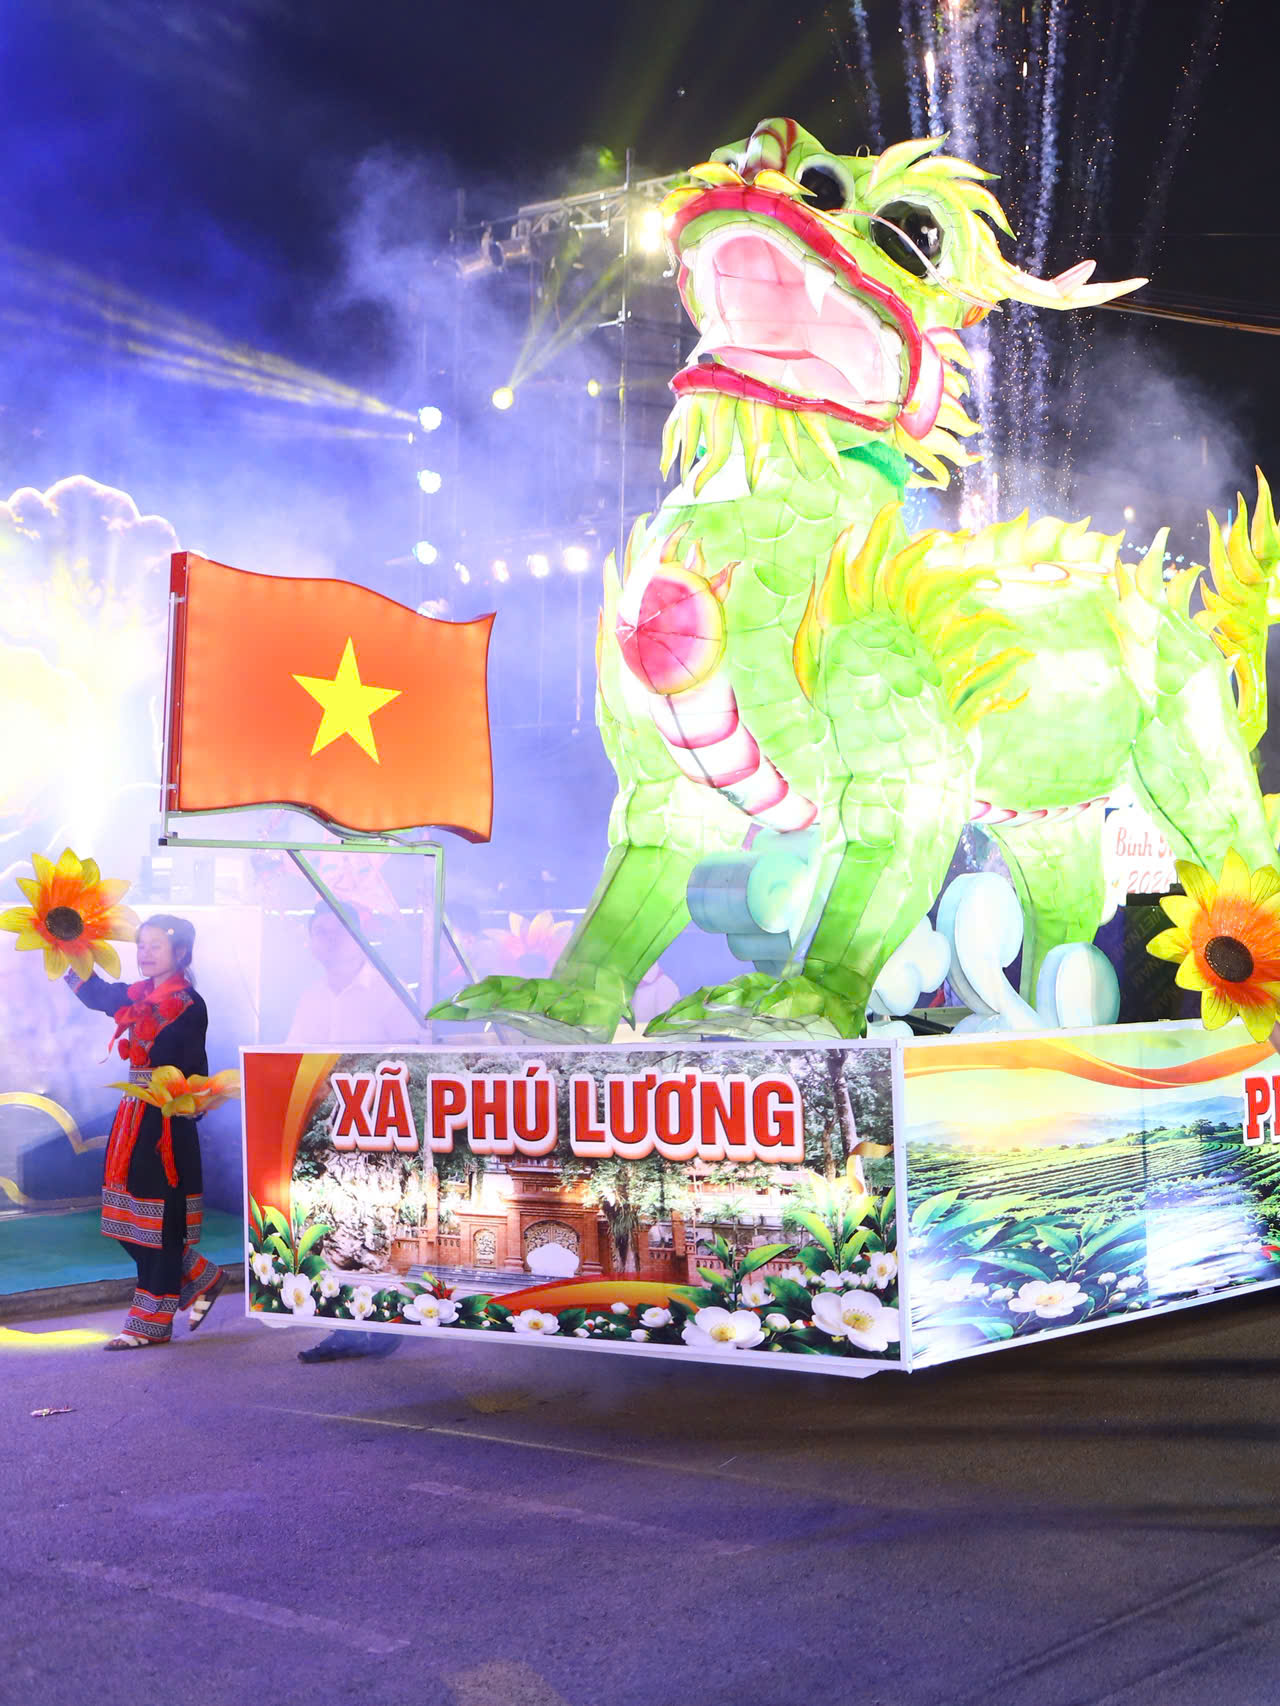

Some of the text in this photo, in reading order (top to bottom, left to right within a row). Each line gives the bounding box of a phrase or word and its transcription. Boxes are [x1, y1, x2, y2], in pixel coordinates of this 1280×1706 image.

[334, 1064, 797, 1148] XÃ PHÚ LƯƠNG
